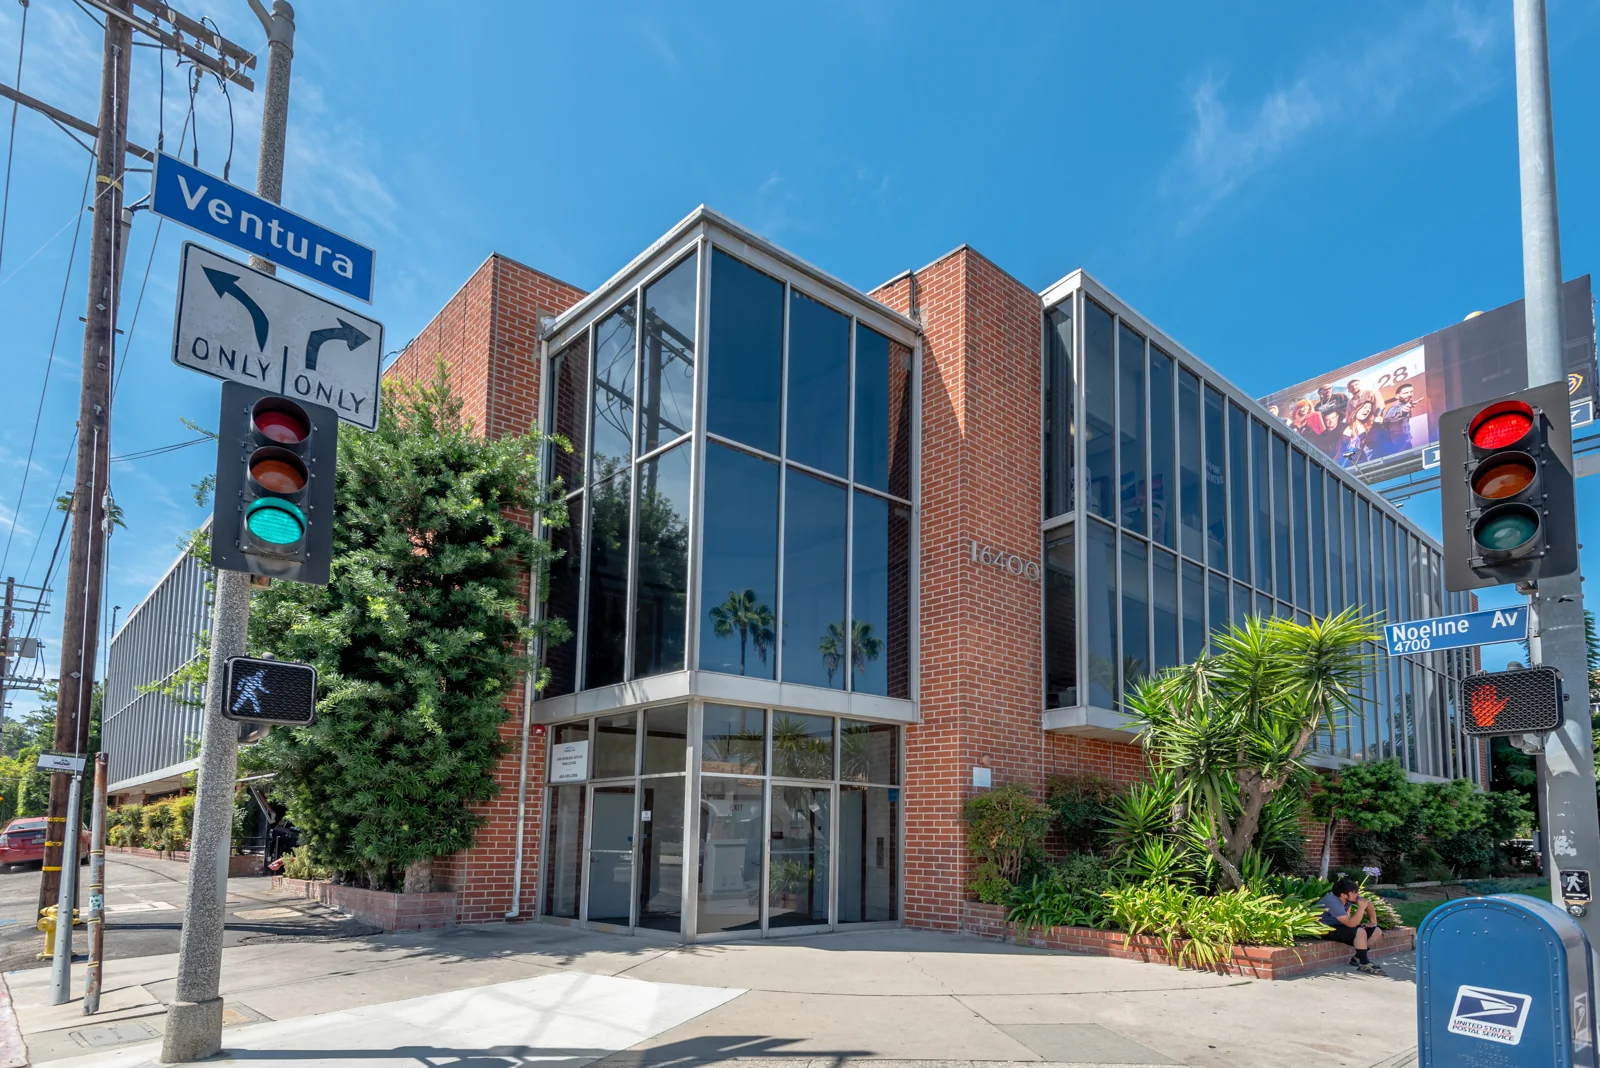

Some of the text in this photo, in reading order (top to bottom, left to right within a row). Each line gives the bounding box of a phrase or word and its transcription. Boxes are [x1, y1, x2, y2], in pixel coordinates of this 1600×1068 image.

[177, 174, 354, 280] Ventura
[191, 336, 271, 382] ONLY
[294, 374, 367, 415] ONLY
[971, 540, 1040, 581] 16400
[1392, 611, 1518, 643] Noeline Av
[1394, 638, 1431, 653] 4700
[729, 803, 744, 812] EXIT
[1452, 1025, 1515, 1041] POSTAL SERVICE
[1453, 1019, 1512, 1035] UNITED STATES
